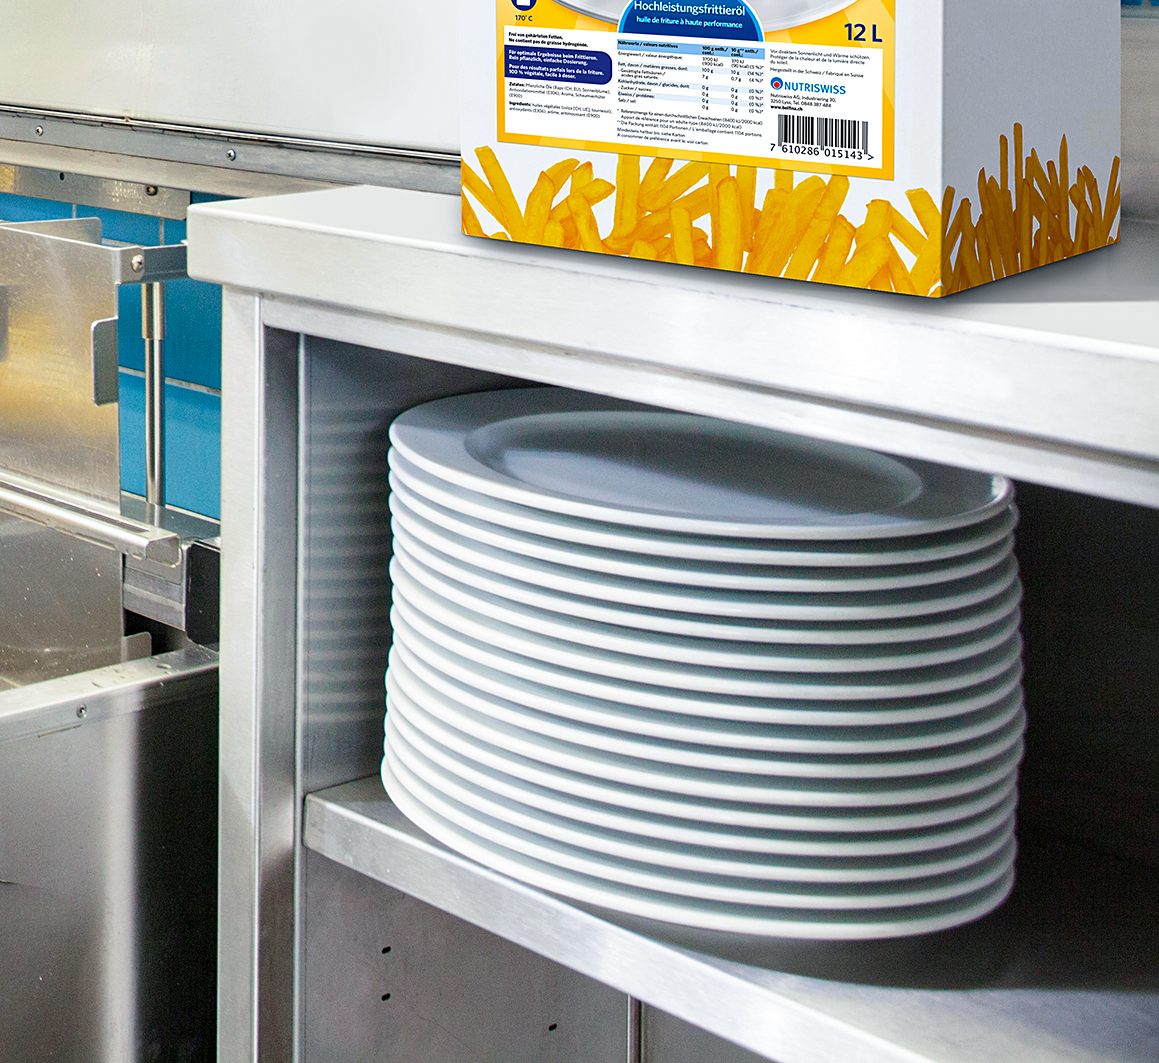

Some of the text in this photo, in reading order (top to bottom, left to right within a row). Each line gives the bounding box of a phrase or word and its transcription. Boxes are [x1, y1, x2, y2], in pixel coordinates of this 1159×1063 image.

[634, 0, 746, 16] Hochleistungsfrittieröl
[636, 16, 651, 24] huile
[660, 17, 679, 25] friture
[685, 19, 702, 27] haute
[703, 20, 743, 29] performance
[843, 23, 883, 43] 12 L
[785, 82, 846, 95] NUTRISWISS
[770, 143, 776, 152] 7
[782, 144, 819, 156] 610286
[824, 148, 863, 160] 015143
